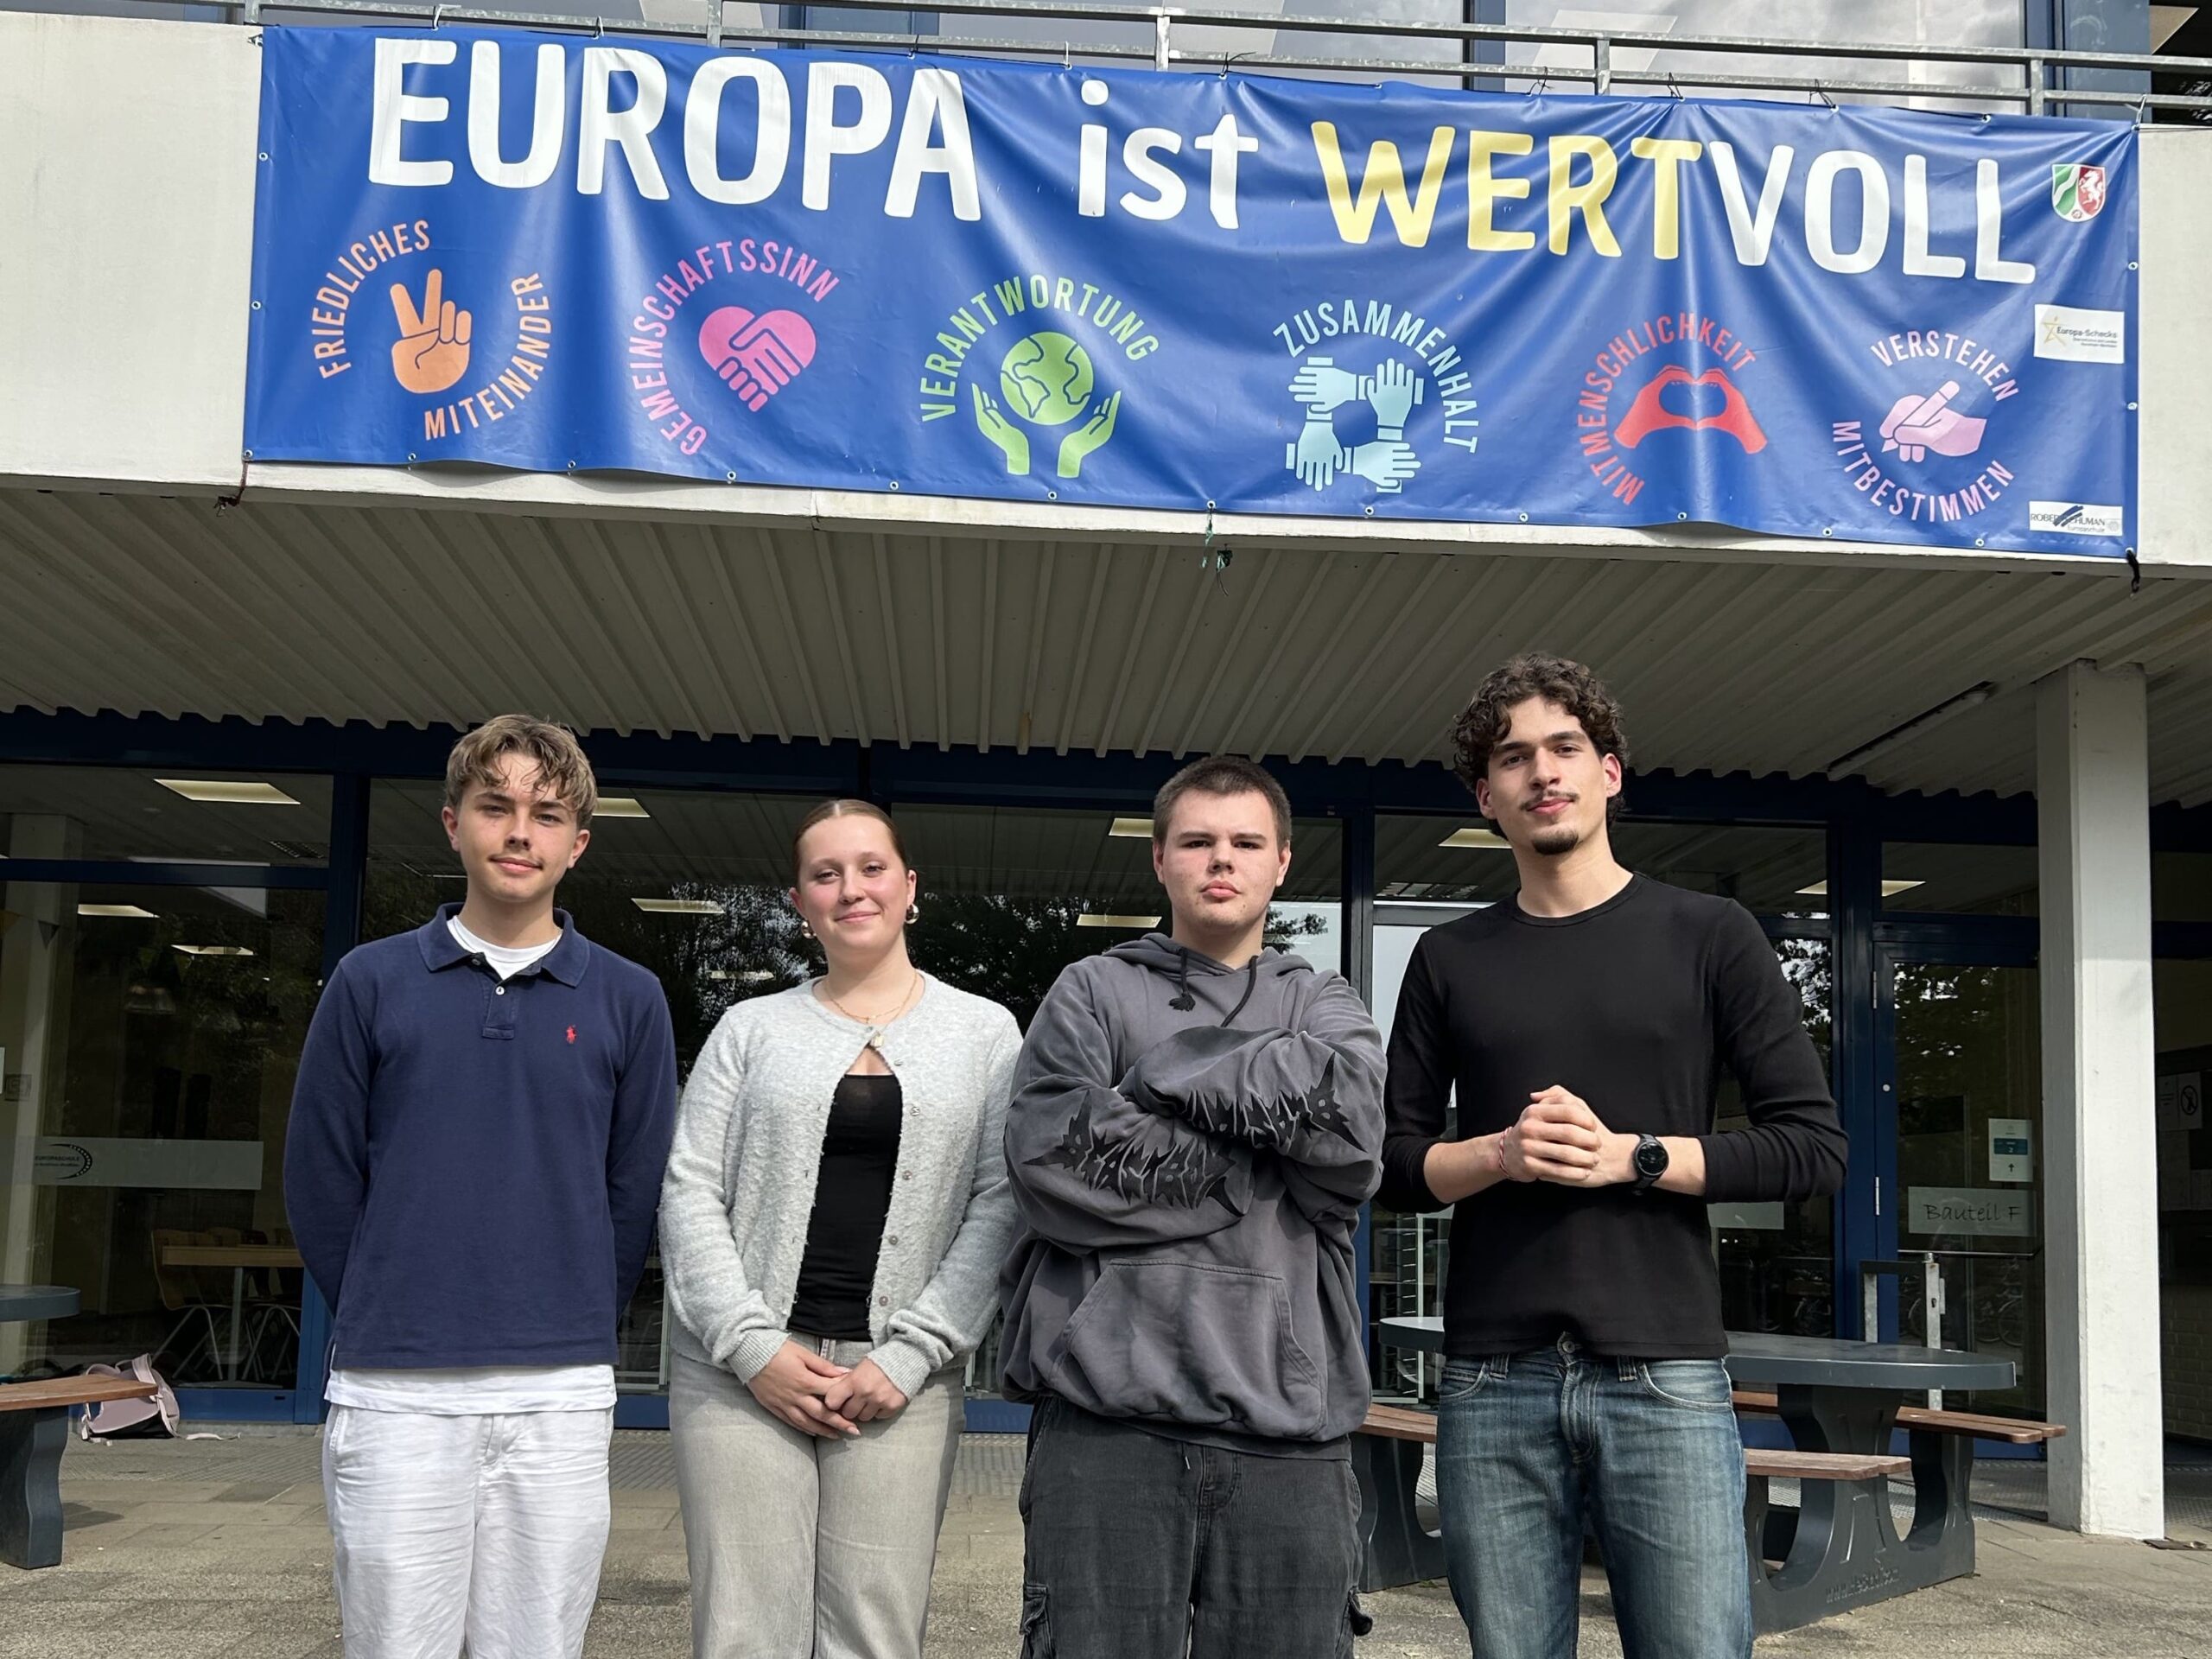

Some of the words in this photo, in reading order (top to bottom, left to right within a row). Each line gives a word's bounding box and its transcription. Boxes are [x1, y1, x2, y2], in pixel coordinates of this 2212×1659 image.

[369, 38, 981, 222] EUROPA
[1078, 79, 1259, 230] ist
[1311, 121, 2037, 284] WERTVOLL
[311, 219, 431, 379] FRIEDLICHES
[424, 272, 551, 442] MITEINANDER
[628, 238, 840, 456] GEMEINSCHAFTSSINN
[921, 274, 1160, 422] VERANTWORTUNG
[1273, 298, 1479, 454] ZUSAMMENHALT
[1870, 329, 2018, 403] VERSTEHEN
[1577, 312, 1758, 505] MITMENSCHLICHKEIT
[1833, 420, 2016, 523] MITBESTIMMEN
[2030, 513, 2061, 523] ROBER
[1923, 1202, 2000, 1222] Bauteil
[2007, 1205, 2022, 1222] F
